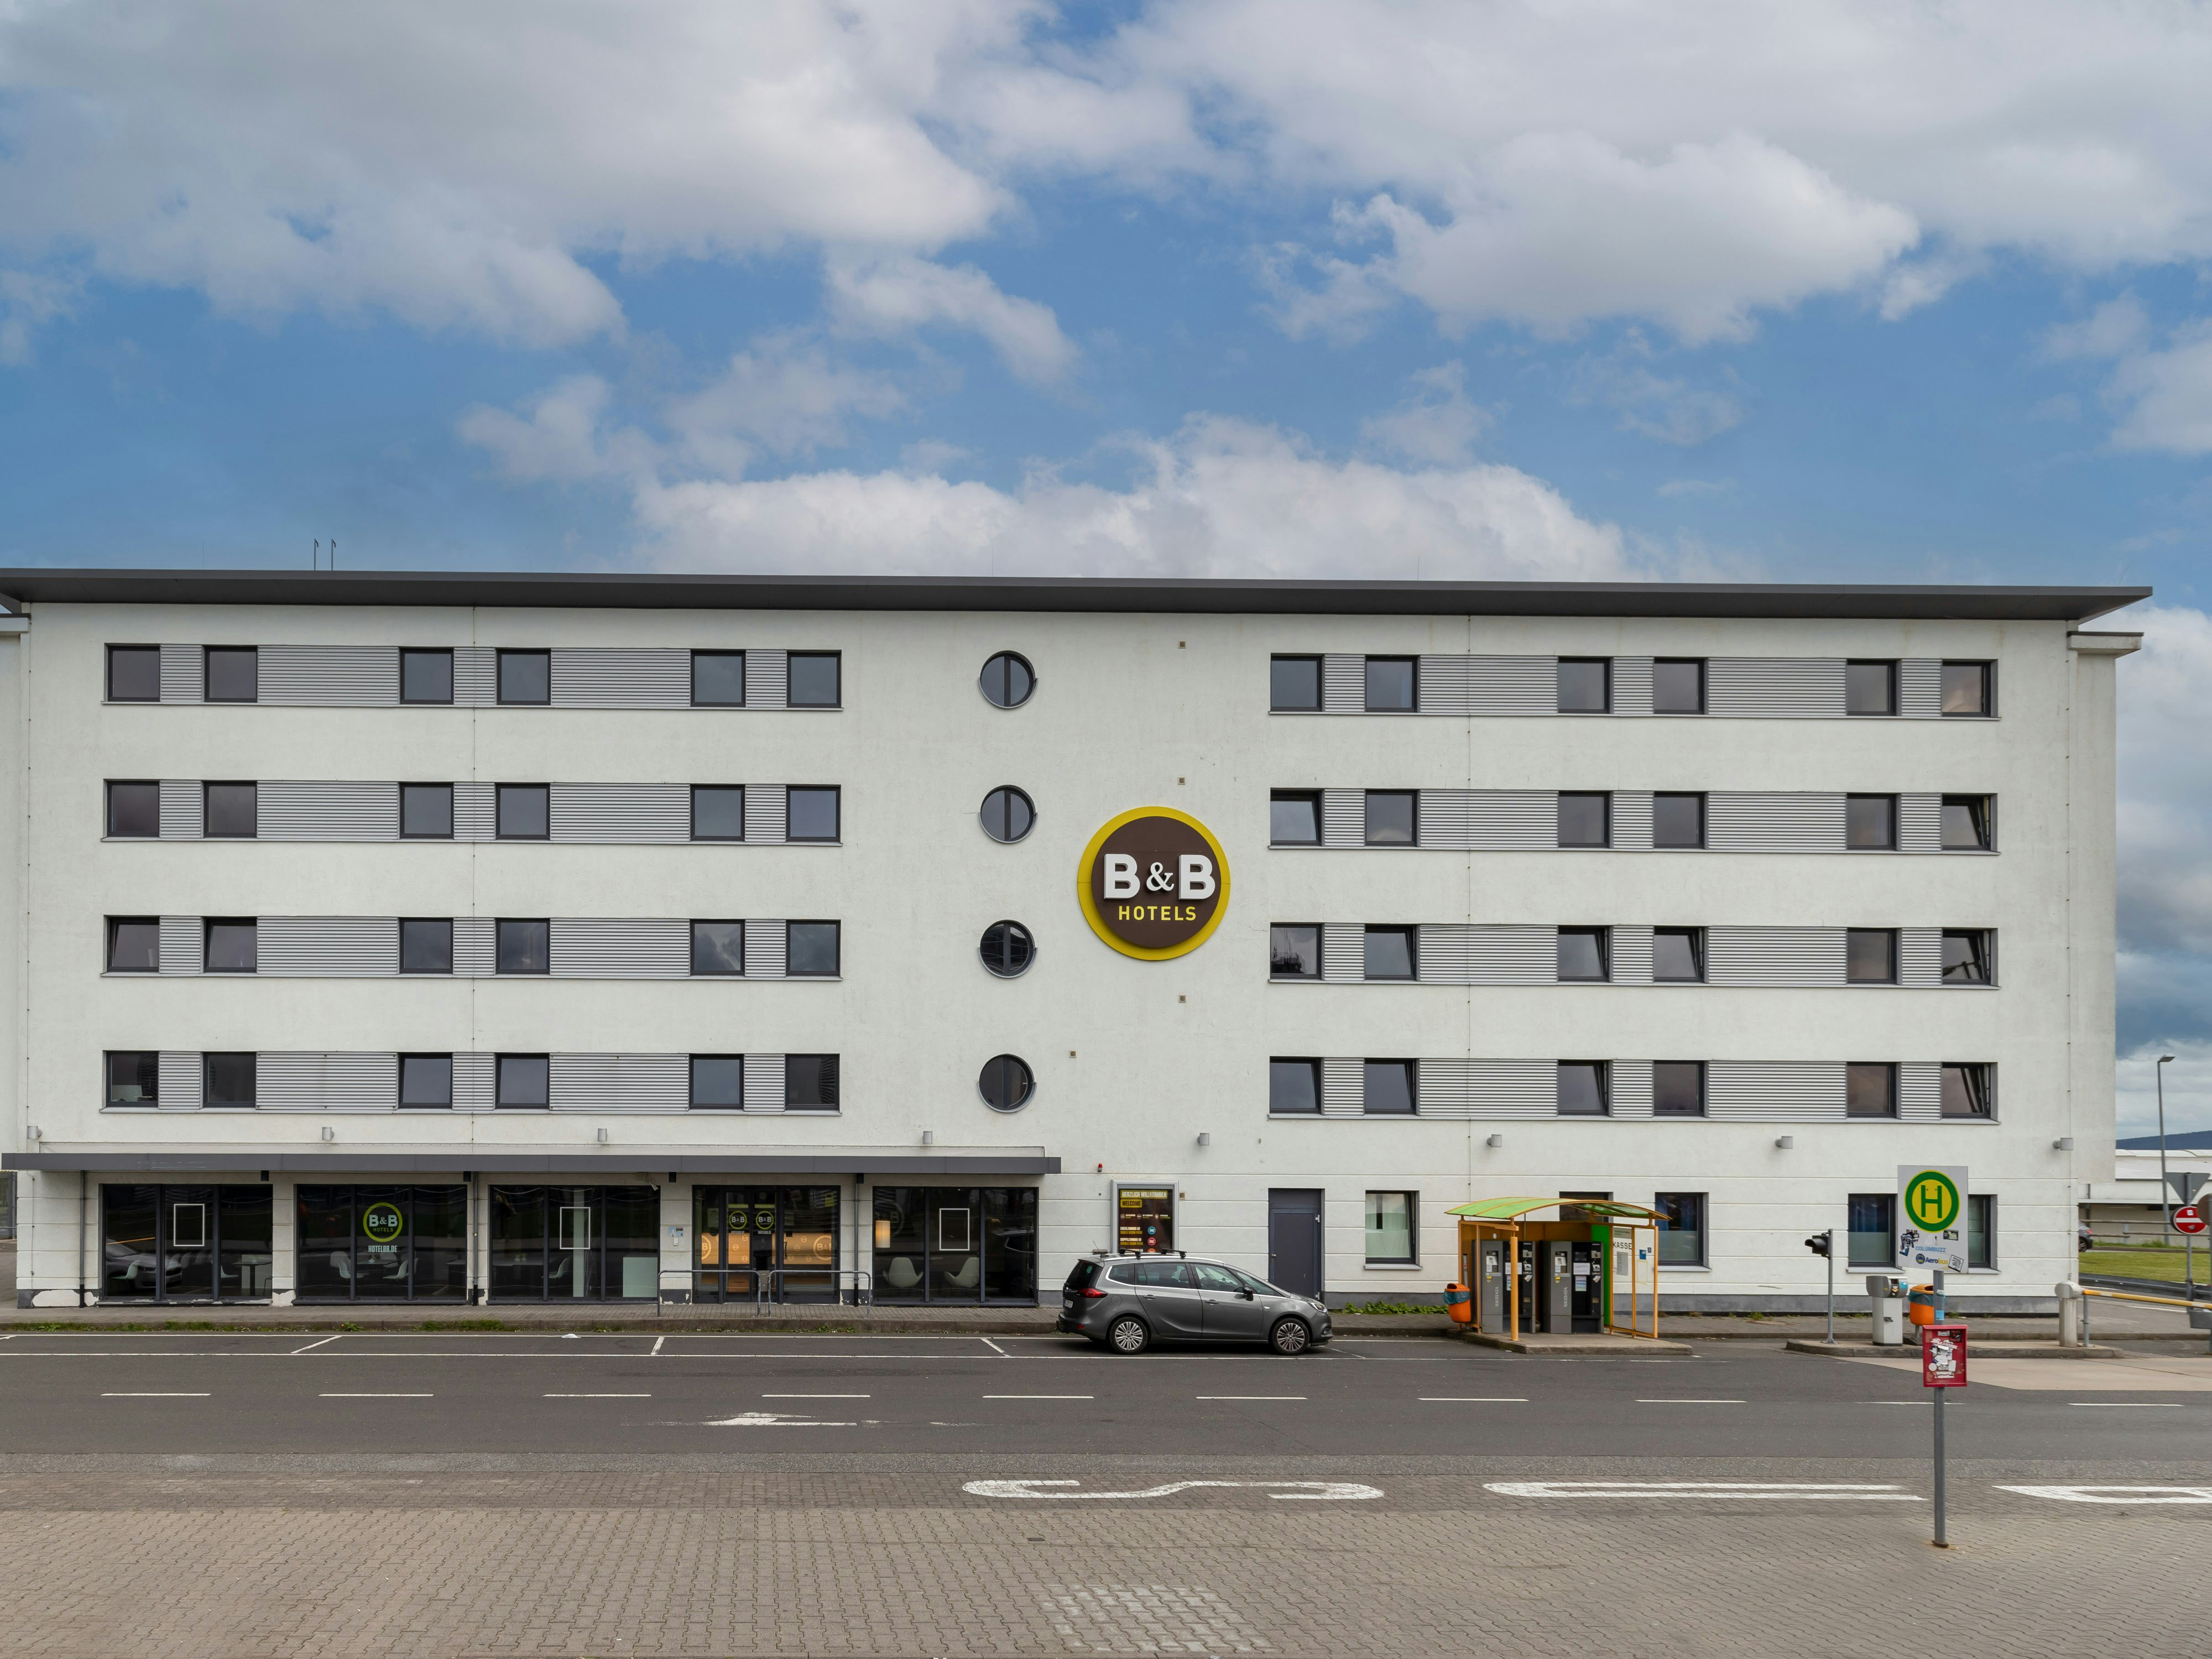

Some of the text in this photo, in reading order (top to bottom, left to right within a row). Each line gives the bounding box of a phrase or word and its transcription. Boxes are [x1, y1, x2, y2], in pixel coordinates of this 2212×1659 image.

[1119, 906, 1196, 921] HOTELS
[1921, 1185, 1942, 1218] H
[369, 1215, 398, 1227] B&B
[1613, 1241, 1632, 1250] KASSE
